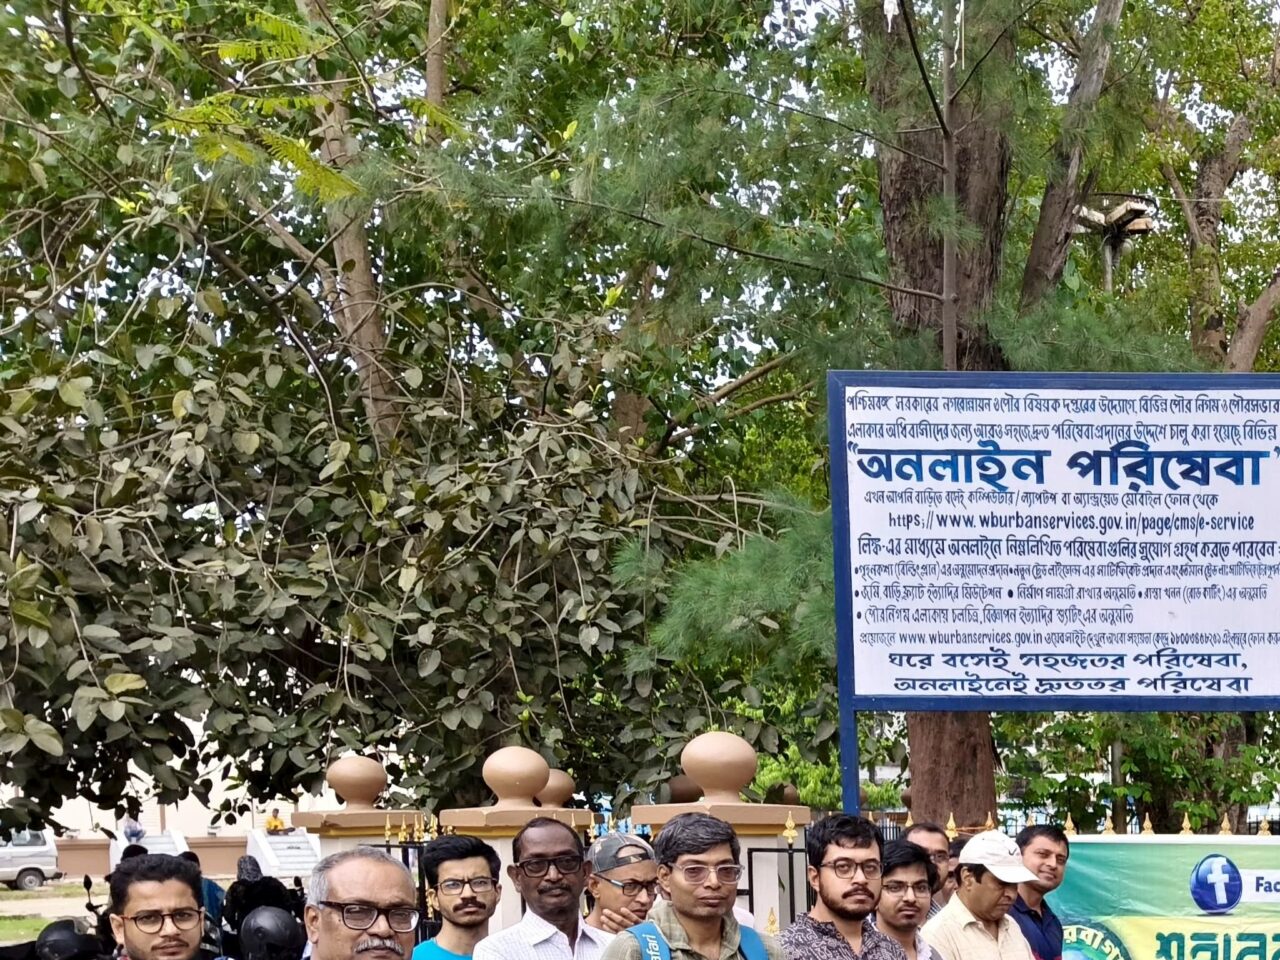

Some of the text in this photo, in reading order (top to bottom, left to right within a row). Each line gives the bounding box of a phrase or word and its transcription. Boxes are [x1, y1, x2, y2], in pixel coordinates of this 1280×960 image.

[846, 389, 894, 412] পশ্চিমবঙ্গ
[895, 395, 939, 414] সরকারের
[1023, 393, 1061, 414] বিষয়ক
[1062, 398, 1096, 414] দপ্তরের
[1139, 394, 1168, 413] বিভিন্ন
[1169, 394, 1191, 414] পৌর
[1193, 393, 1219, 414] নিগম
[848, 422, 884, 439] এলাকার
[886, 416, 949, 442] অধিবাসীদের
[950, 423, 972, 443] জন্য
[1051, 418, 1094, 442] পরিষেবা
[1094, 424, 1133, 445] প্রদানের
[1169, 423, 1190, 446] চালু
[1191, 424, 1211, 442] করা
[1213, 424, 1242, 445] হয়েছে
[1243, 419, 1278, 442] বিভিন্ন
[864, 490, 885, 504] এখন
[886, 487, 914, 504] আপনি
[914, 487, 943, 508] বাড়িতে
[944, 488, 967, 510] বসেই
[1061, 492, 1072, 506] বা
[1121, 491, 1163, 509] মোবাইল
[1164, 493, 1191, 510] ফোন
[1192, 493, 1219, 510] থেকে
[904, 538, 946, 559] মাধ্যমে
[948, 534, 1003, 560] অনলাইনে
[1006, 533, 1062, 557] নিম্নলিখিত
[1138, 541, 1171, 563] সুযোগ
[1173, 541, 1199, 562] গ্রহণ
[1200, 541, 1231, 562] করতে
[1082, 564, 1095, 578] এর
[1141, 565, 1164, 578] প্রদান
[1017, 583, 1044, 600] নির্মাণ
[1103, 583, 1136, 602] অনুমতি
[912, 608, 949, 624] এলাকায়
[1018, 605, 1055, 627] ইত্যাদির
[1099, 603, 1134, 627] অনুমতি
[888, 652, 935, 670] ঘরে
[941, 646, 1012, 674] বসেই
[1018, 652, 1128, 674] সহজতর
[893, 670, 1254, 695] অনলাইনেই দ্রুততর পরিষেবা
